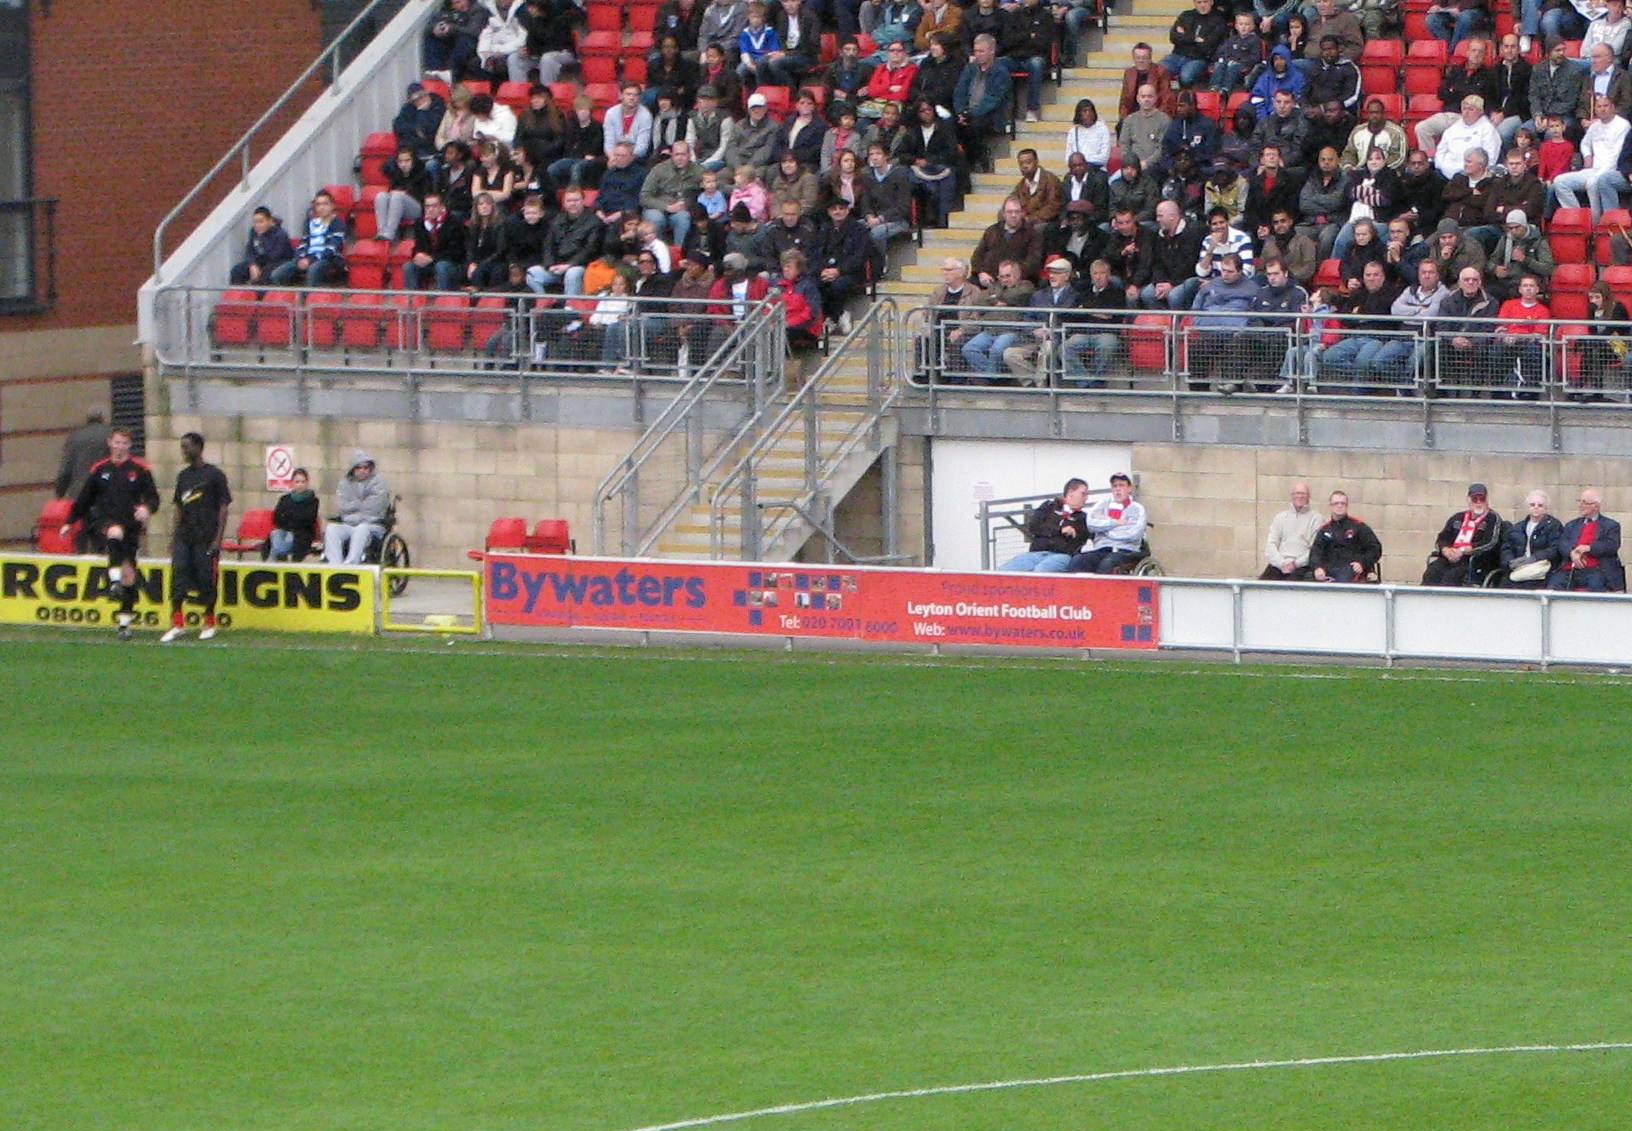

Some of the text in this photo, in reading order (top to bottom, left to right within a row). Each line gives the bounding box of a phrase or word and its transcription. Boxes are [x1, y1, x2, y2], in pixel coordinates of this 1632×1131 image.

[187, 570, 361, 611] IGNS
[491, 561, 706, 613] Bywaters
[36, 606, 100, 622] 0800
[908, 601, 1092, 620] Leyton Orient Football Club
[779, 615, 800, 629] Tel:
[914, 622, 1086, 639] Web: www.bywaters.co.uk
